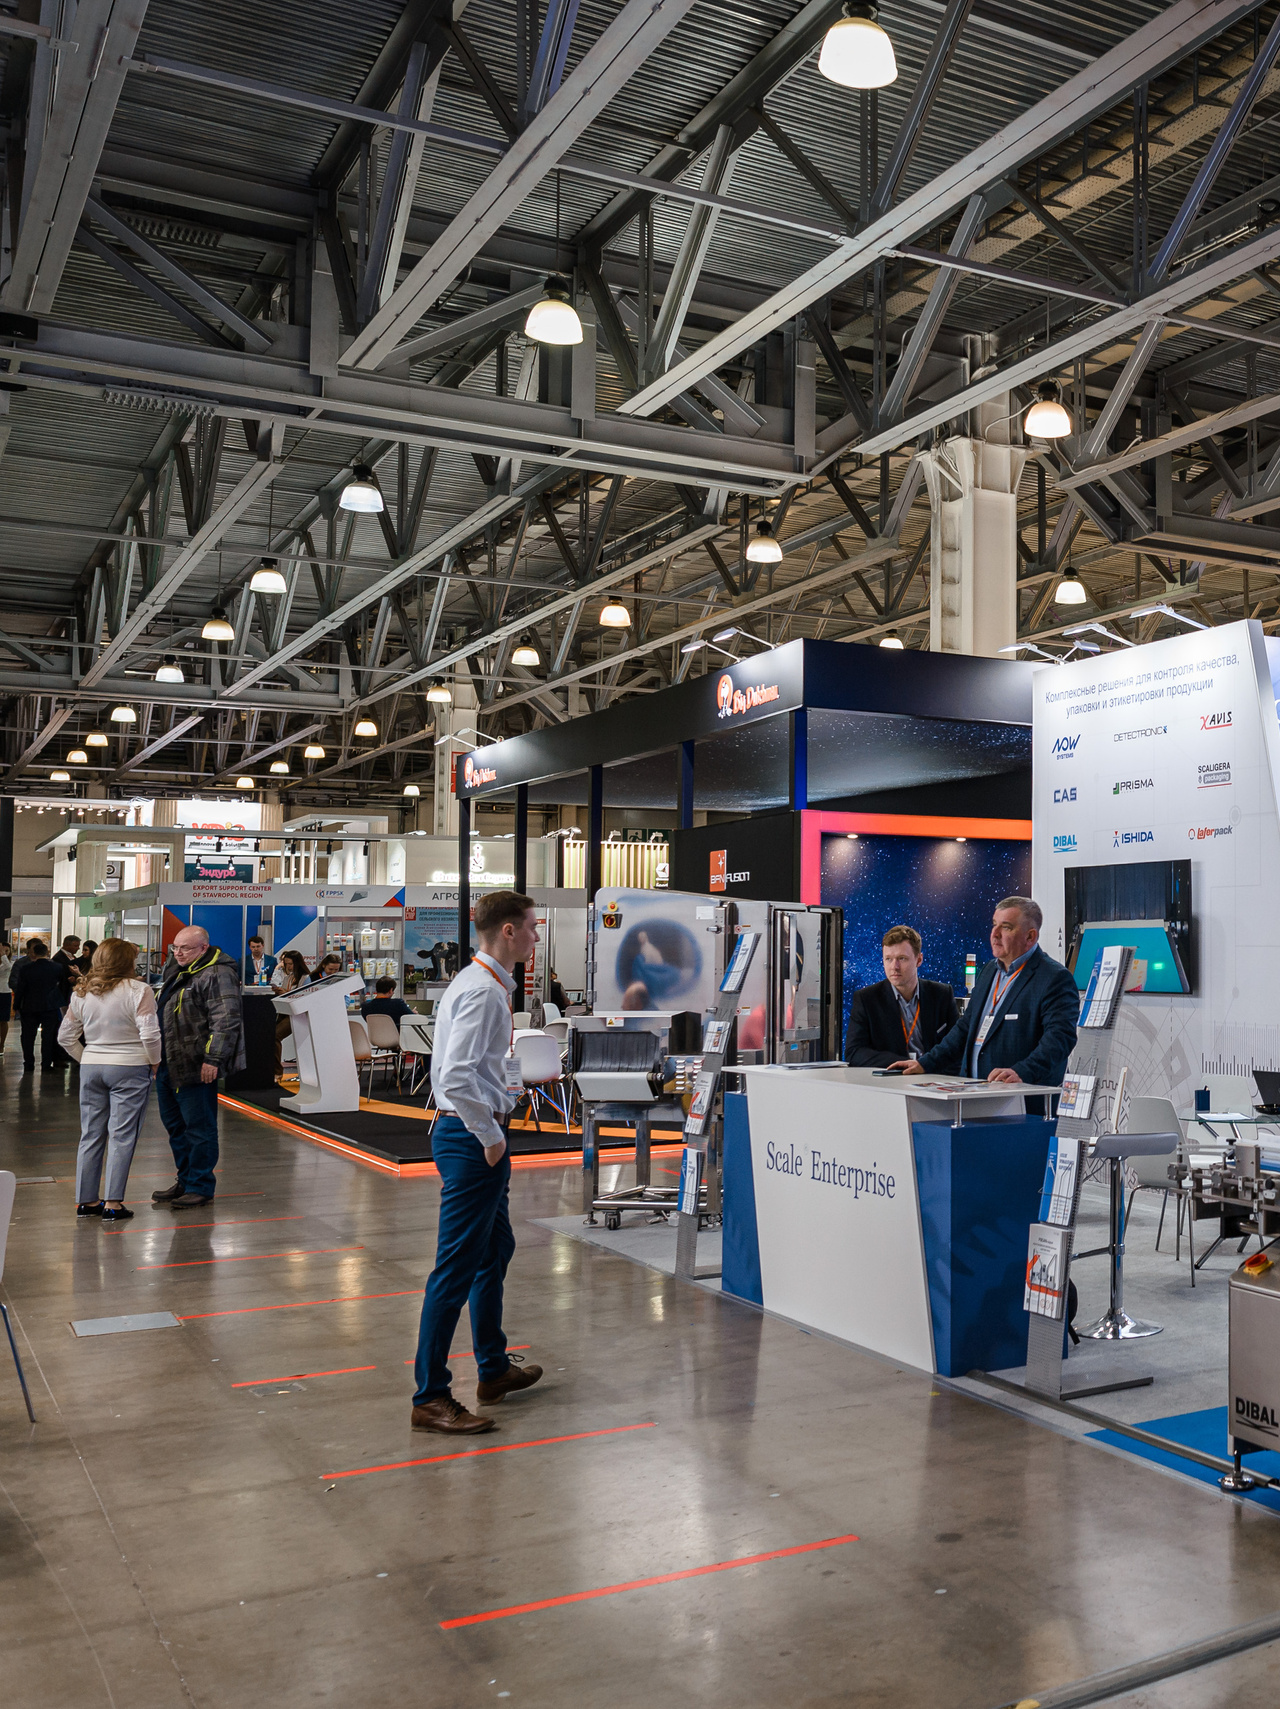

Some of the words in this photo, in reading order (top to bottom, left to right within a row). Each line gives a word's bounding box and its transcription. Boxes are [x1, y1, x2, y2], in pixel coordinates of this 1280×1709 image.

[1045, 683, 1097, 704] Комплексные
[1098, 676, 1134, 695] решения
[1135, 673, 1153, 687] для
[1153, 664, 1195, 683] контроля
[1196, 653, 1241, 673] качества,
[1066, 701, 1101, 719] упаковки
[1102, 700, 1108, 709] и
[1109, 689, 1165, 709] этикетировки
[1166, 677, 1214, 700] продукции
[1199, 711, 1233, 731] XAVIS
[1056, 752, 1074, 761] SYSTEMS
[1197, 761, 1231, 774] SCALIGERA
[1204, 772, 1230, 783] packaging
[1053, 787, 1078, 803] CAS
[1053, 834, 1078, 848] DIBAL
[1121, 830, 1154, 845] ISHIDA
[766, 1141, 803, 1176] Scale
[811, 1150, 896, 1200] Enterprise
[1235, 1396, 1280, 1428] DIBAL
